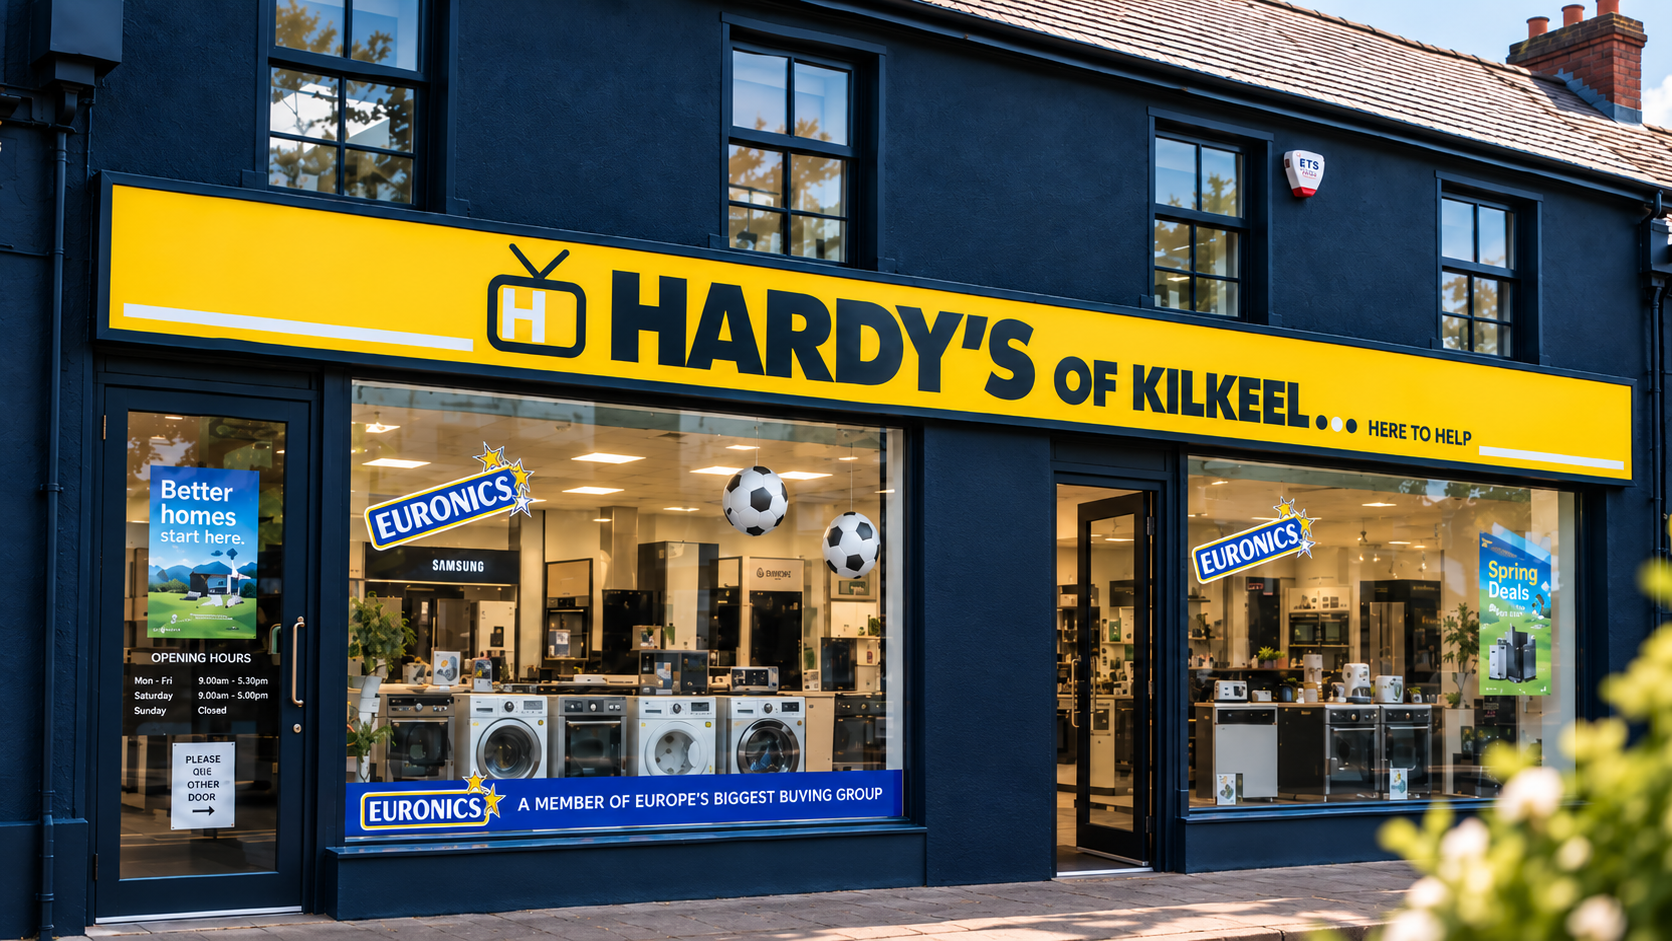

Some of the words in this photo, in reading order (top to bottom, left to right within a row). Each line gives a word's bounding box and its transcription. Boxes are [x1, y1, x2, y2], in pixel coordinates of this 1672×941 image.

[1300, 158, 1319, 170] ETS
[502, 288, 545, 343] H
[611, 270, 1035, 400] HARDY'S
[1054, 357, 1117, 407] OF
[1368, 420, 1407, 440] HERE
[1410, 425, 1431, 442] TO
[1435, 428, 1472, 446] HELP
[162, 480, 233, 502] Better
[161, 503, 236, 526] homes
[375, 476, 513, 540] EURONICS
[160, 529, 200, 544] start
[205, 529, 245, 545] here.
[1200, 523, 1299, 575] EURONICS
[432, 558, 485, 573] SAMSUNG
[1488, 560, 1538, 586] Spring
[1488, 581, 1530, 600] Deals
[151, 652, 206, 664] OPENING
[210, 653, 252, 664] HOURS
[134, 676, 154, 685] Mon
[161, 676, 173, 685] Fri
[198, 676, 229, 685] 9.00am
[237, 676, 269, 687] 5.30pm
[134, 691, 174, 702] Saturday
[198, 691, 229, 700] 9.00am
[237, 691, 269, 701] 5.00pm
[134, 706, 167, 717] Sunday
[198, 706, 227, 715] Closed
[185, 755, 221, 764] PLEASE
[187, 780, 220, 789] OTHER
[188, 793, 216, 802] DOOR
[518, 797, 531, 811] A
[535, 795, 605, 811] MEMBER
[610, 794, 630, 809] OF
[635, 791, 709, 808] EUROPE'S
[714, 790, 776, 805] BIGGEST
[779, 788, 833, 803] BUYING
[836, 787, 883, 801] GROUP
[369, 797, 482, 822] EURONICS
